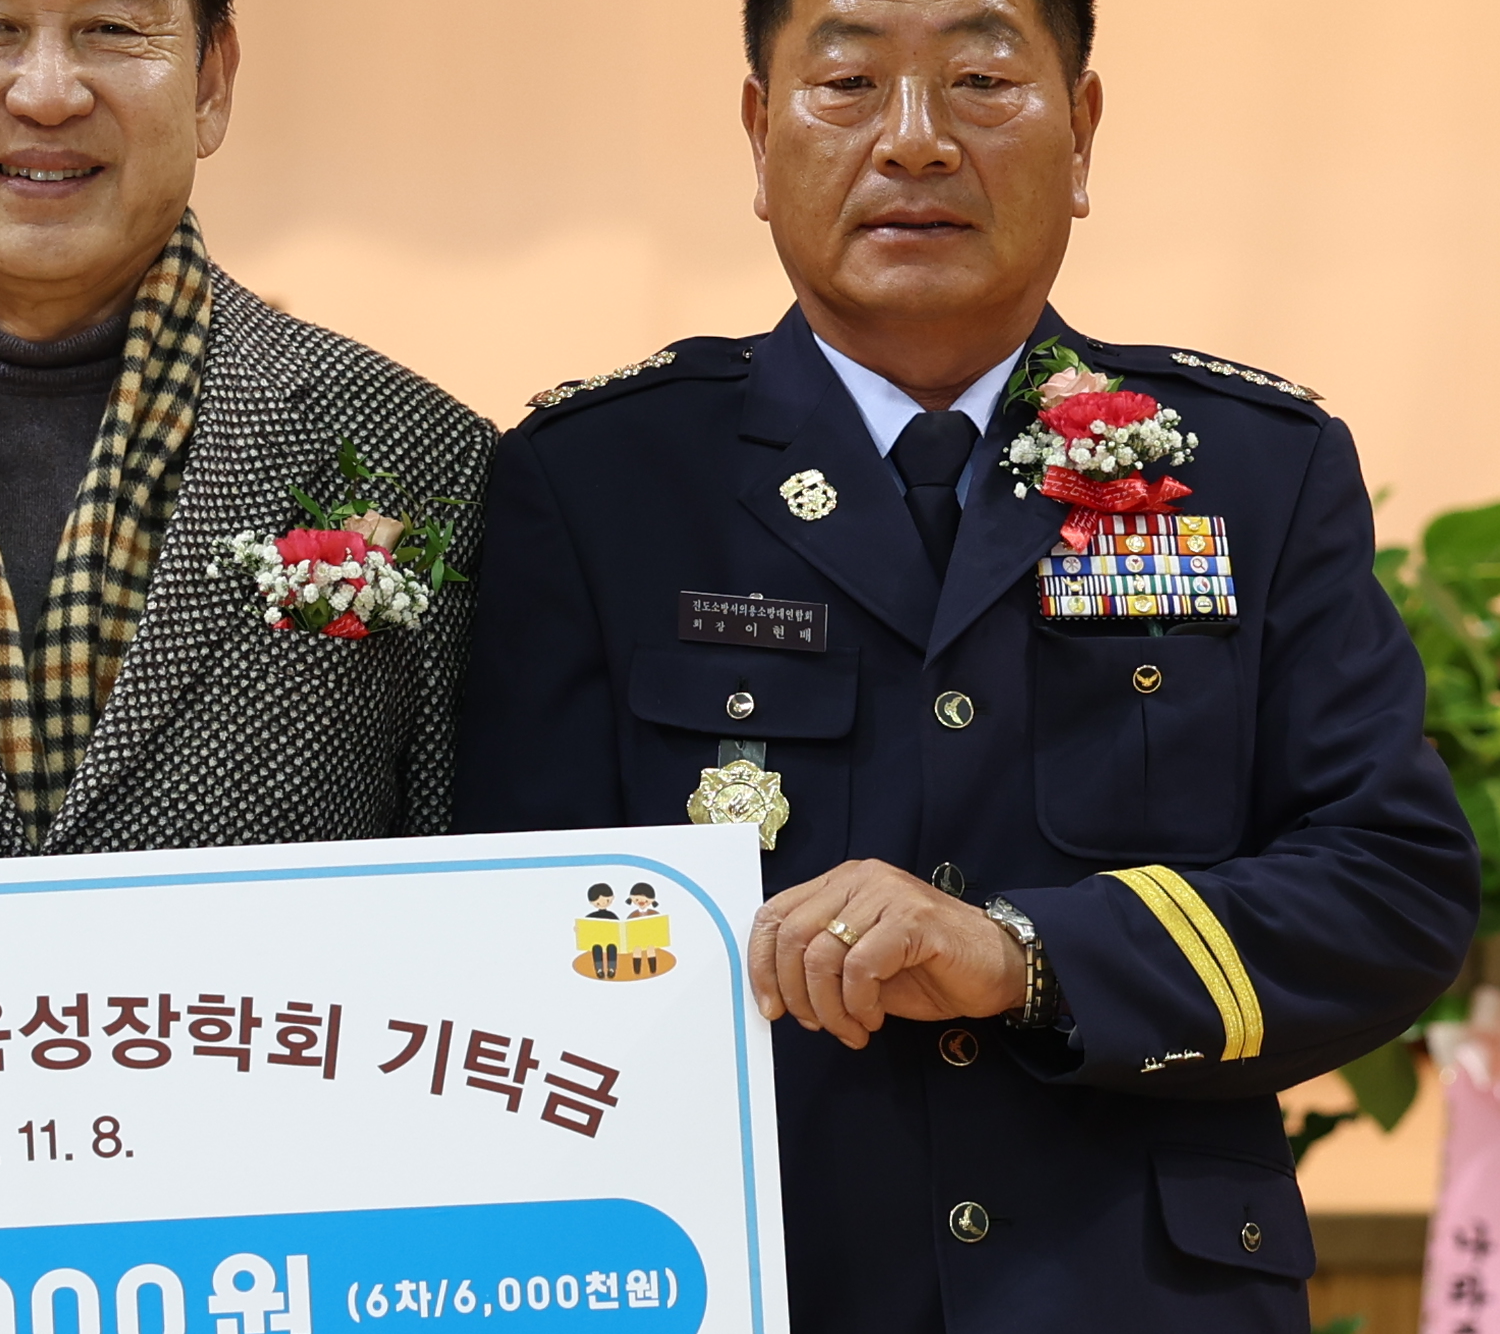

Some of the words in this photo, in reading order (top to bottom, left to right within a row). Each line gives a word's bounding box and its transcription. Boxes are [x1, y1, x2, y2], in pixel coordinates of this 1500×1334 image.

[692, 599, 813, 623] 진도소방서의용소방대연합회
[377, 1019, 621, 1139] 기탁금
[18, 1119, 74, 1163] 11.
[91, 1114, 135, 1160] 8.
[346, 1266, 678, 1324] (6차/6,000천원)
